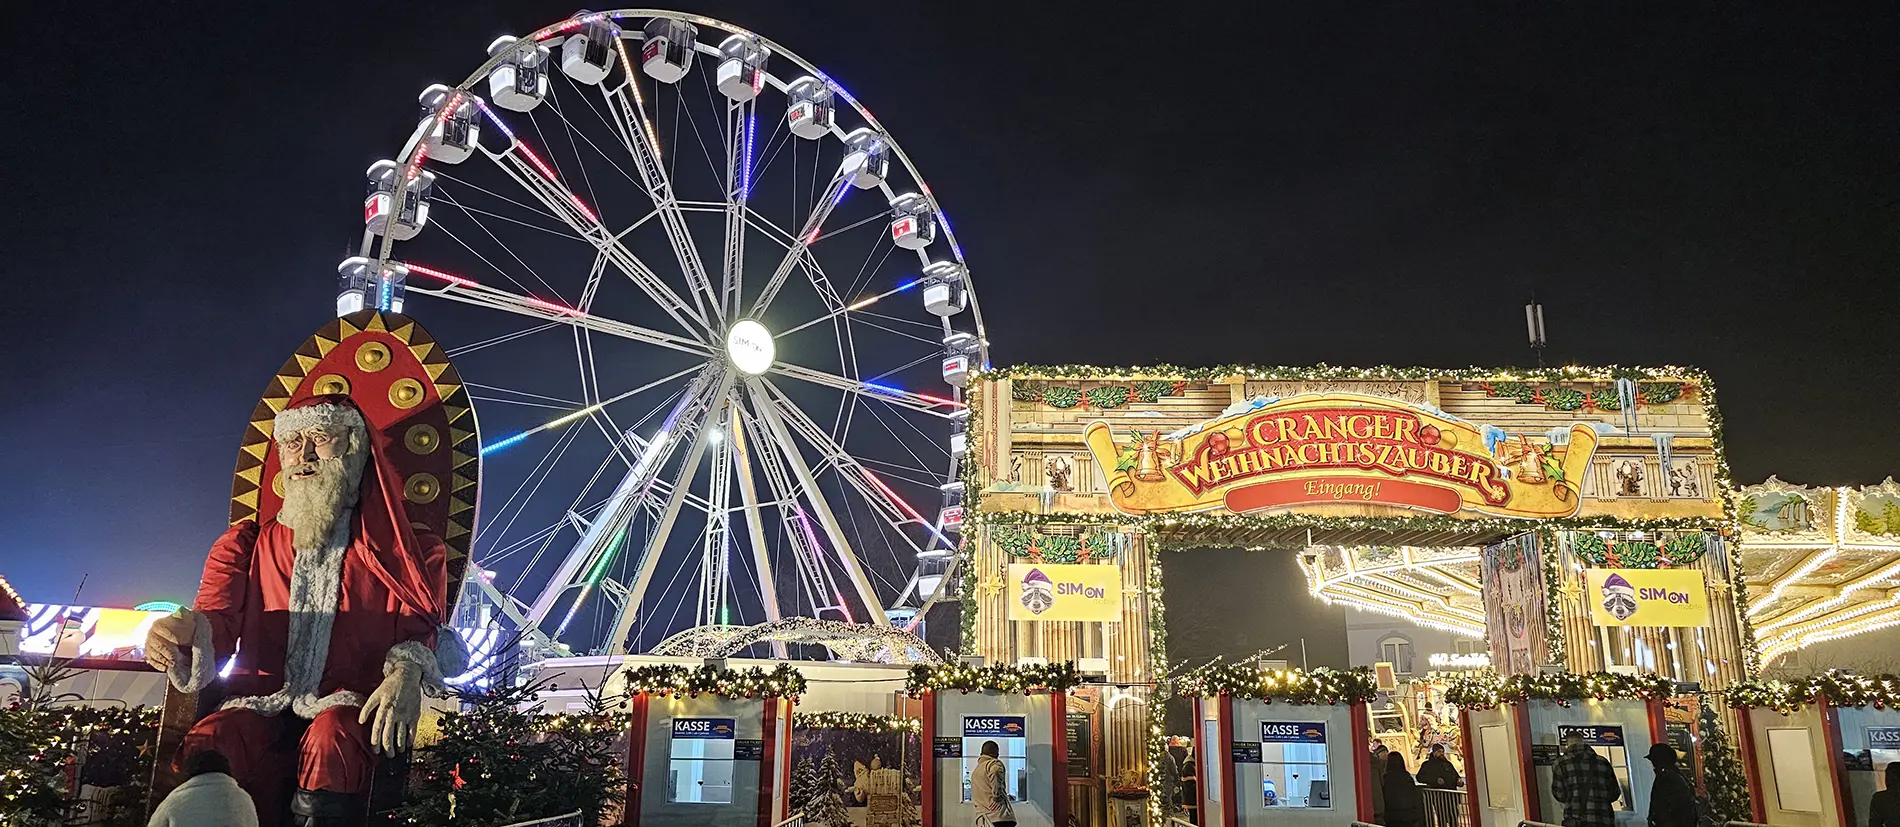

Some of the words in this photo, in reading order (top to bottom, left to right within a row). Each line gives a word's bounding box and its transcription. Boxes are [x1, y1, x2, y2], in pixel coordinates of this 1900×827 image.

[1253, 413, 1418, 445] CRANGER
[1179, 442, 1496, 491] WEIHNACHTSZAUBER
[1304, 479, 1381, 501] Eingang!
[675, 721, 710, 731] KASSE
[965, 719, 1000, 729] KASSE
[1263, 725, 1299, 735] KASSE
